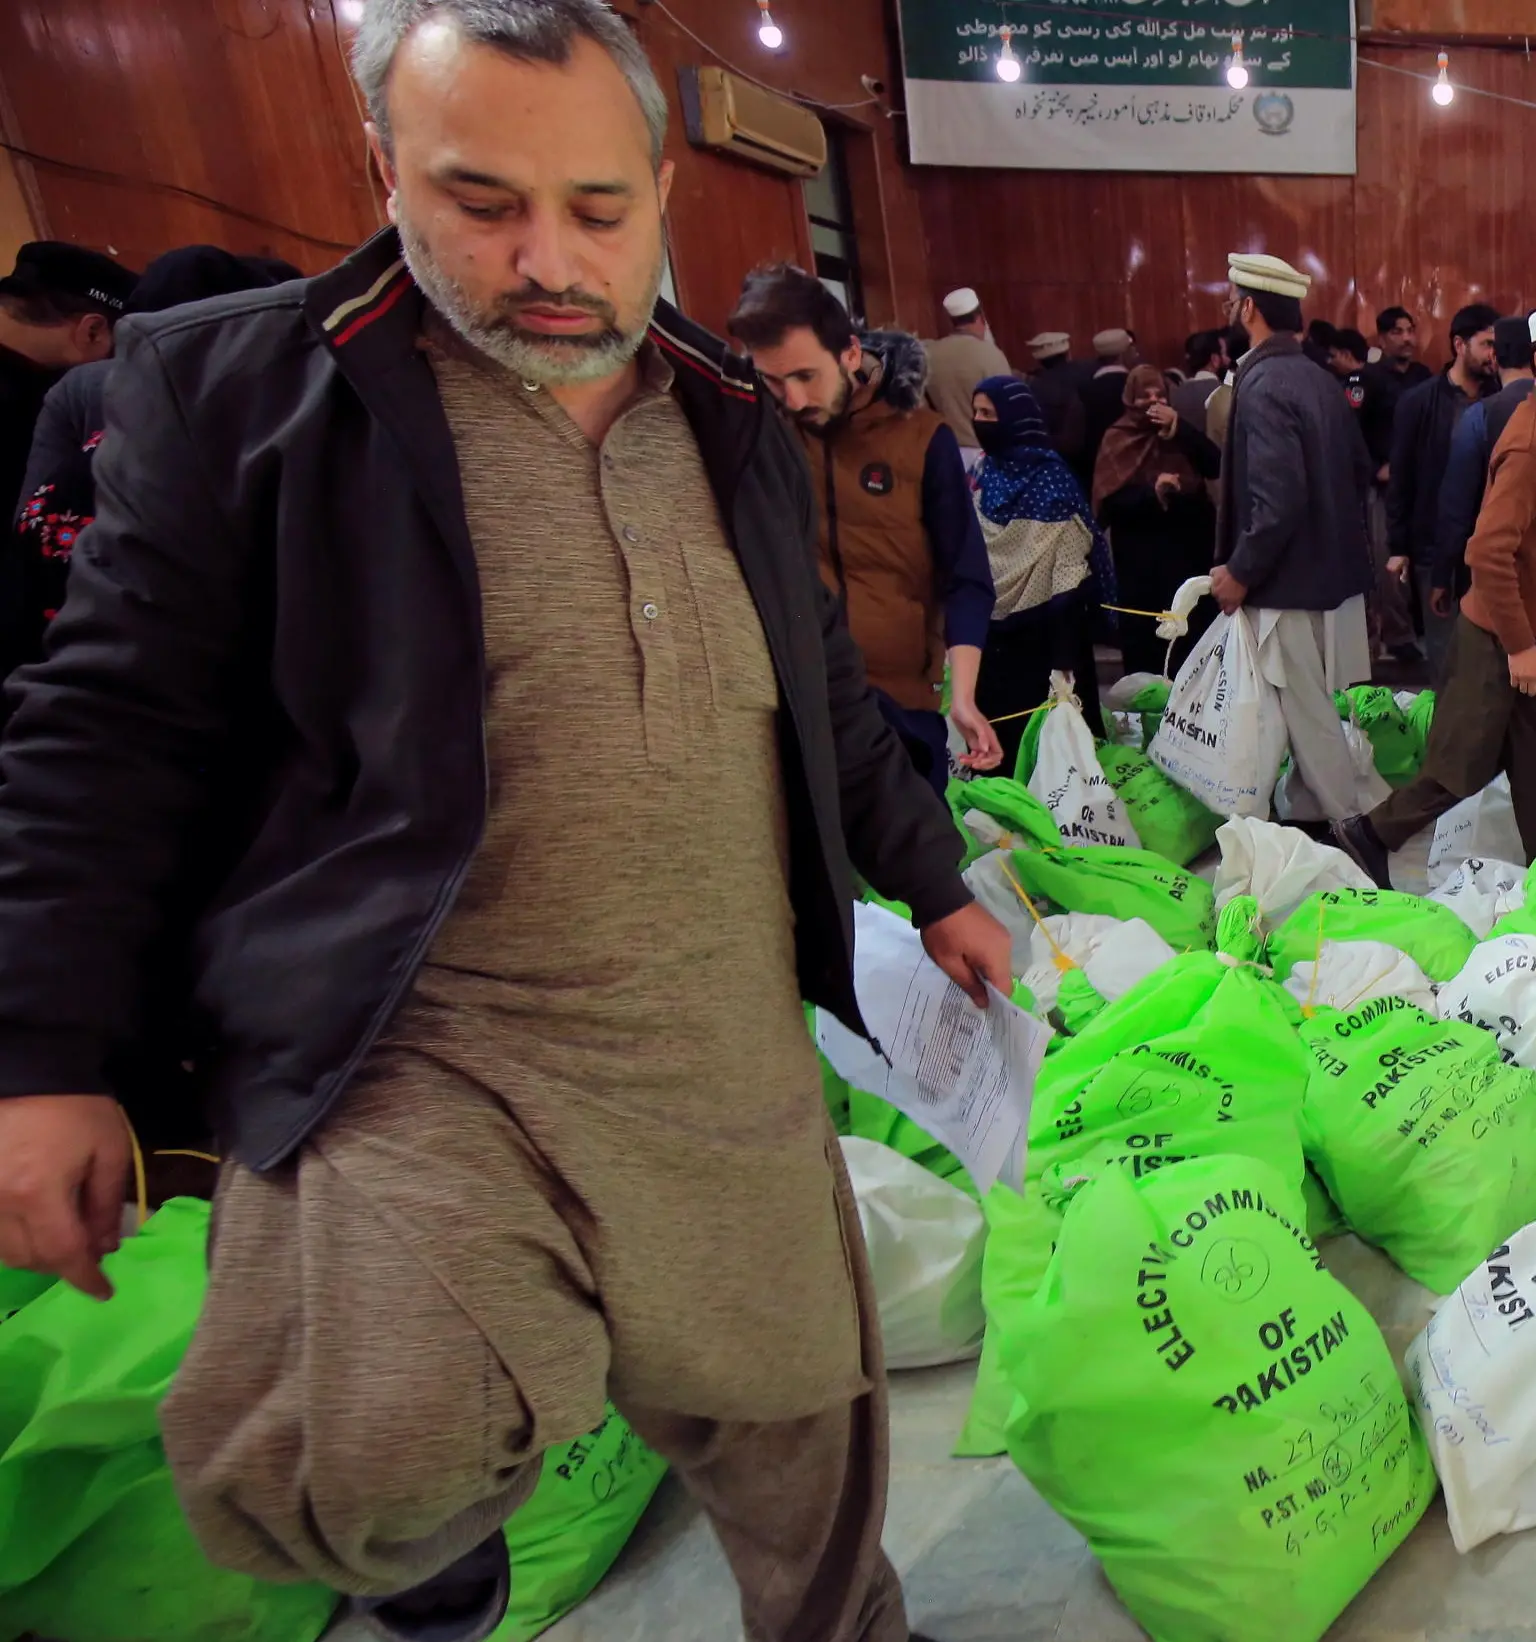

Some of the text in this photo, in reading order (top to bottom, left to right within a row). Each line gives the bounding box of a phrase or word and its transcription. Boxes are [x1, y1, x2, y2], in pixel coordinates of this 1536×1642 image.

[1059, 822, 1126, 847] AKISTAN
[1361, 1036, 1464, 1109] PAKISTAN
[1378, 1047, 1404, 1068] OF
[1125, 1133, 1174, 1149] OF
[1258, 1306, 1297, 1351] OF
[1211, 1310, 1350, 1415] PAKISTAN
[1242, 1464, 1278, 1494] NA.
[1259, 1476, 1332, 1529] P.ST. NO.
